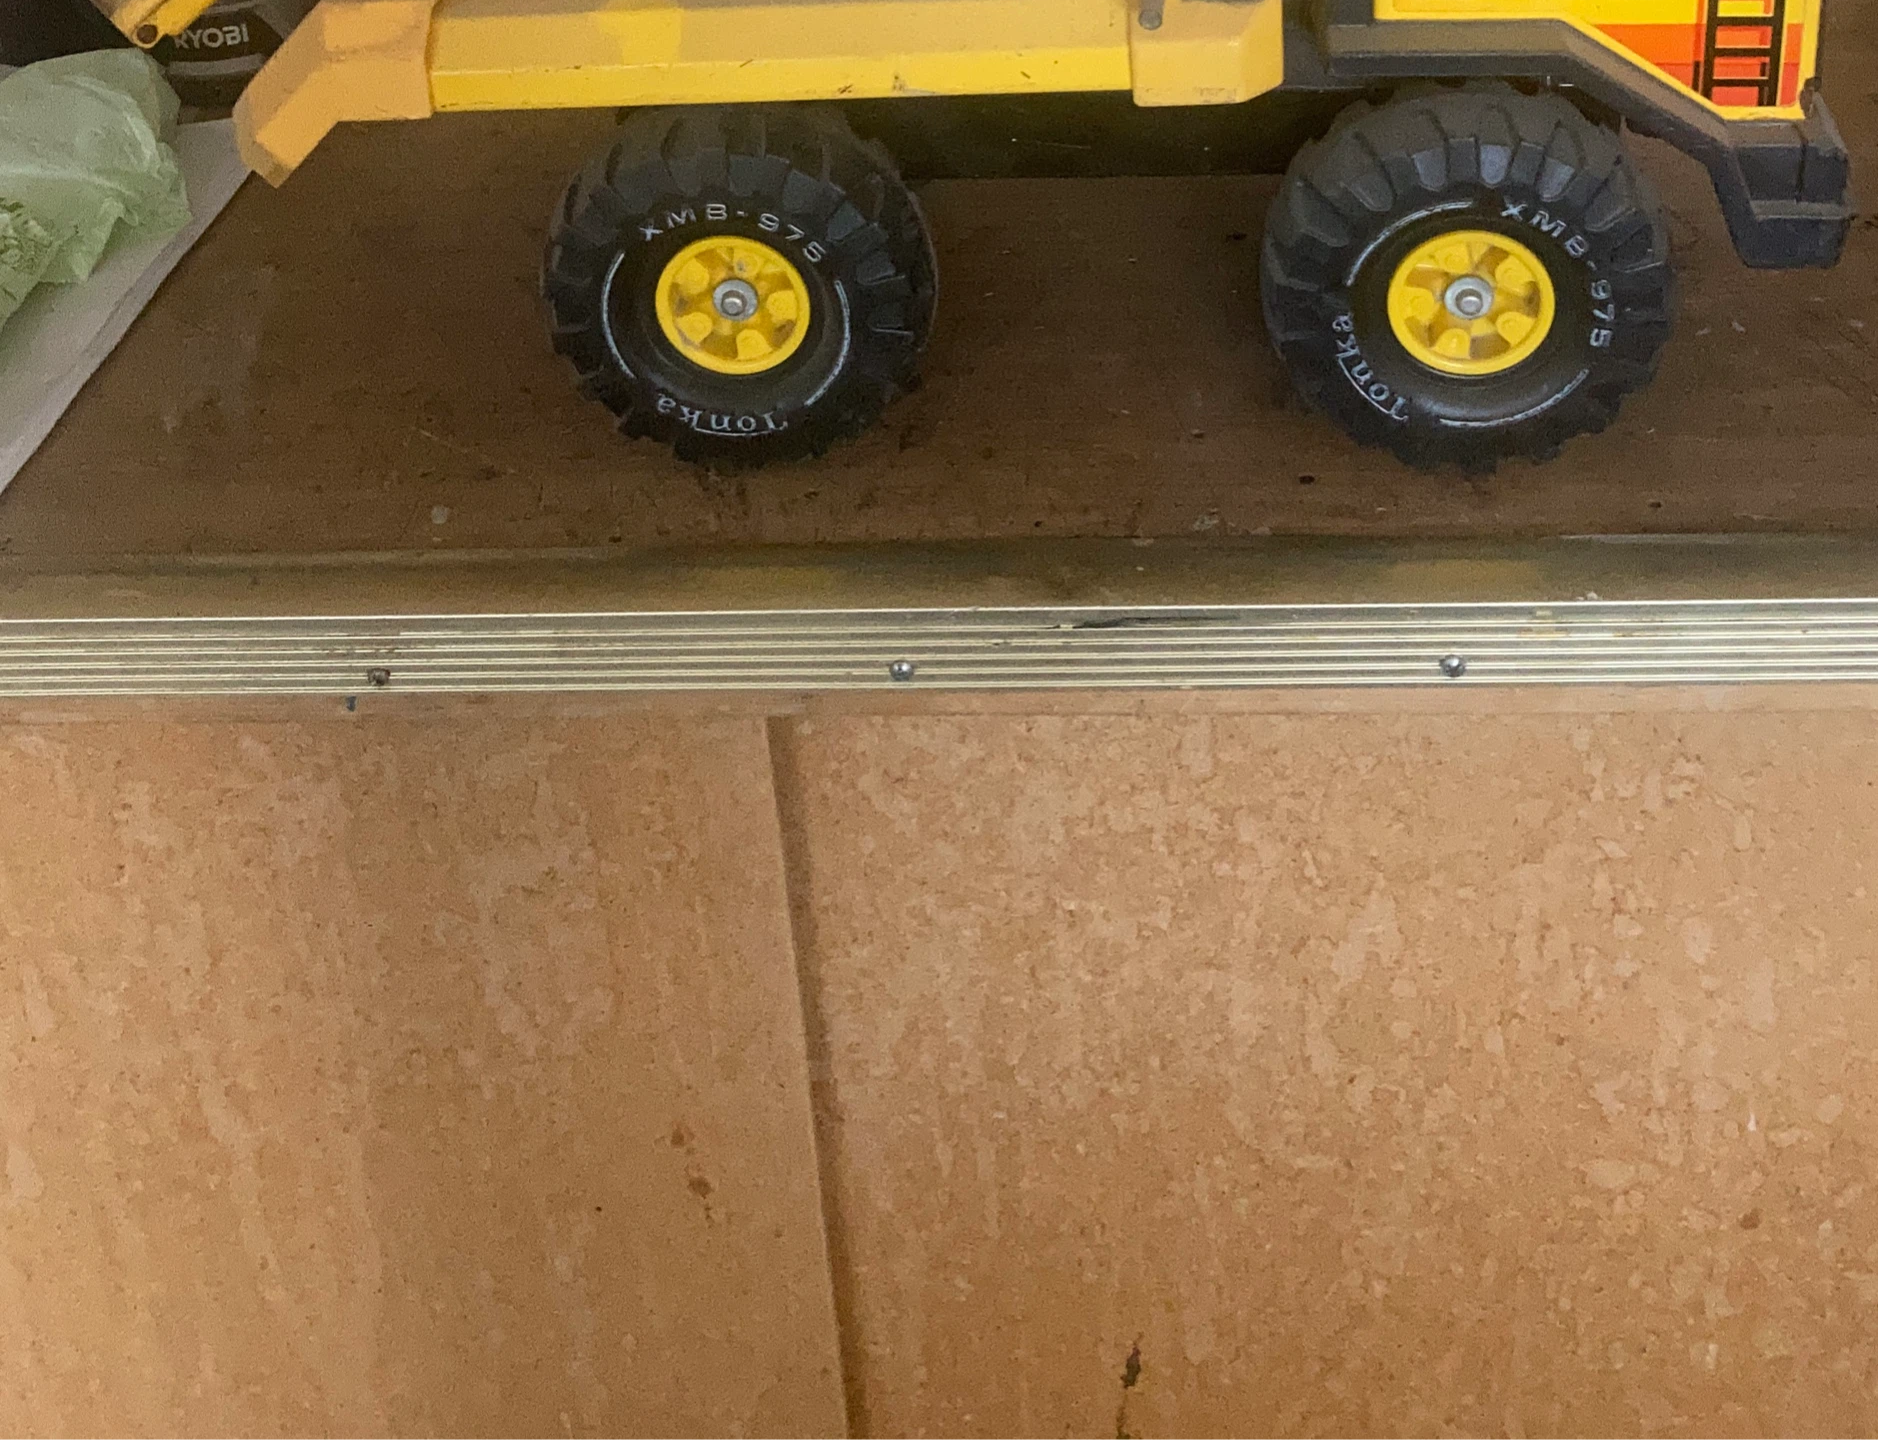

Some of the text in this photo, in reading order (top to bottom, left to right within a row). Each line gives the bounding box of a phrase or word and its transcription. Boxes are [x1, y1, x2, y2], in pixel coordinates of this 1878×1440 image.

[174, 23, 249, 50] RYOBI
[1331, 312, 1409, 422] Tonka
[656, 392, 789, 436] Tonka
